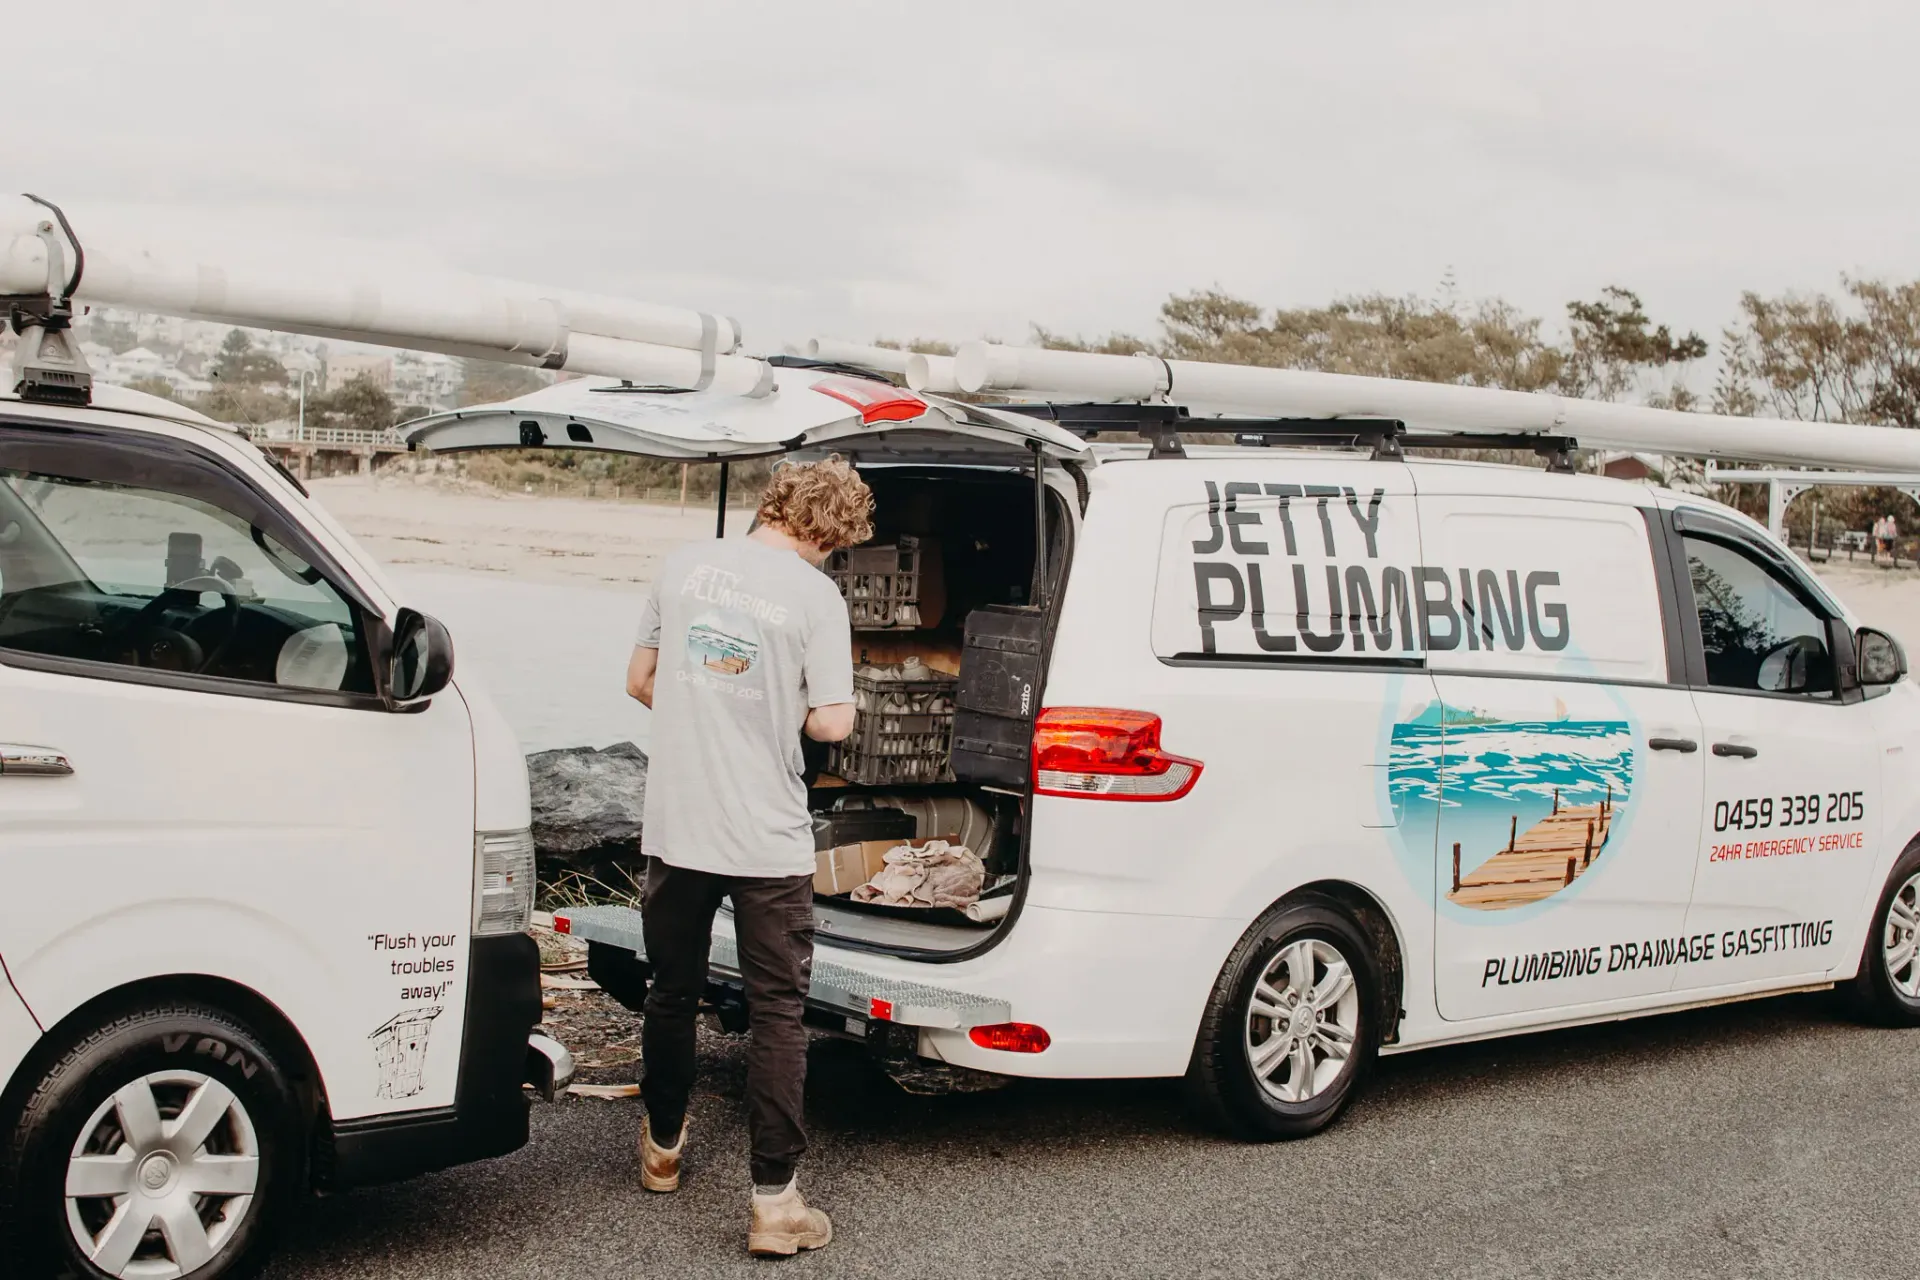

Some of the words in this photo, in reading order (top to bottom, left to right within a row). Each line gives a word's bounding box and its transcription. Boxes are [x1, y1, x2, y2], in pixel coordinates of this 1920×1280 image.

[1192, 480, 1385, 559] JETTY
[687, 564, 745, 590] JETTY
[680, 578, 789, 626] PLUMBING
[1192, 561, 1570, 655] PLUMBING
[1714, 798, 1773, 832] 0459
[1779, 794, 1820, 827] 339
[1826, 791, 1864, 823] 205
[1709, 843, 1742, 863] 24HR
[1745, 836, 1816, 860] EMERGENCY
[1818, 832, 1864, 852] SERVICE
[421, 934, 457, 952] your
[1481, 946, 1602, 988] PLUMBING
[1607, 933, 1715, 973] DRAINAGE
[1722, 919, 1833, 958] GASFITTING
[391, 957, 455, 975] troubles
[160, 1033, 260, 1080] VAN
